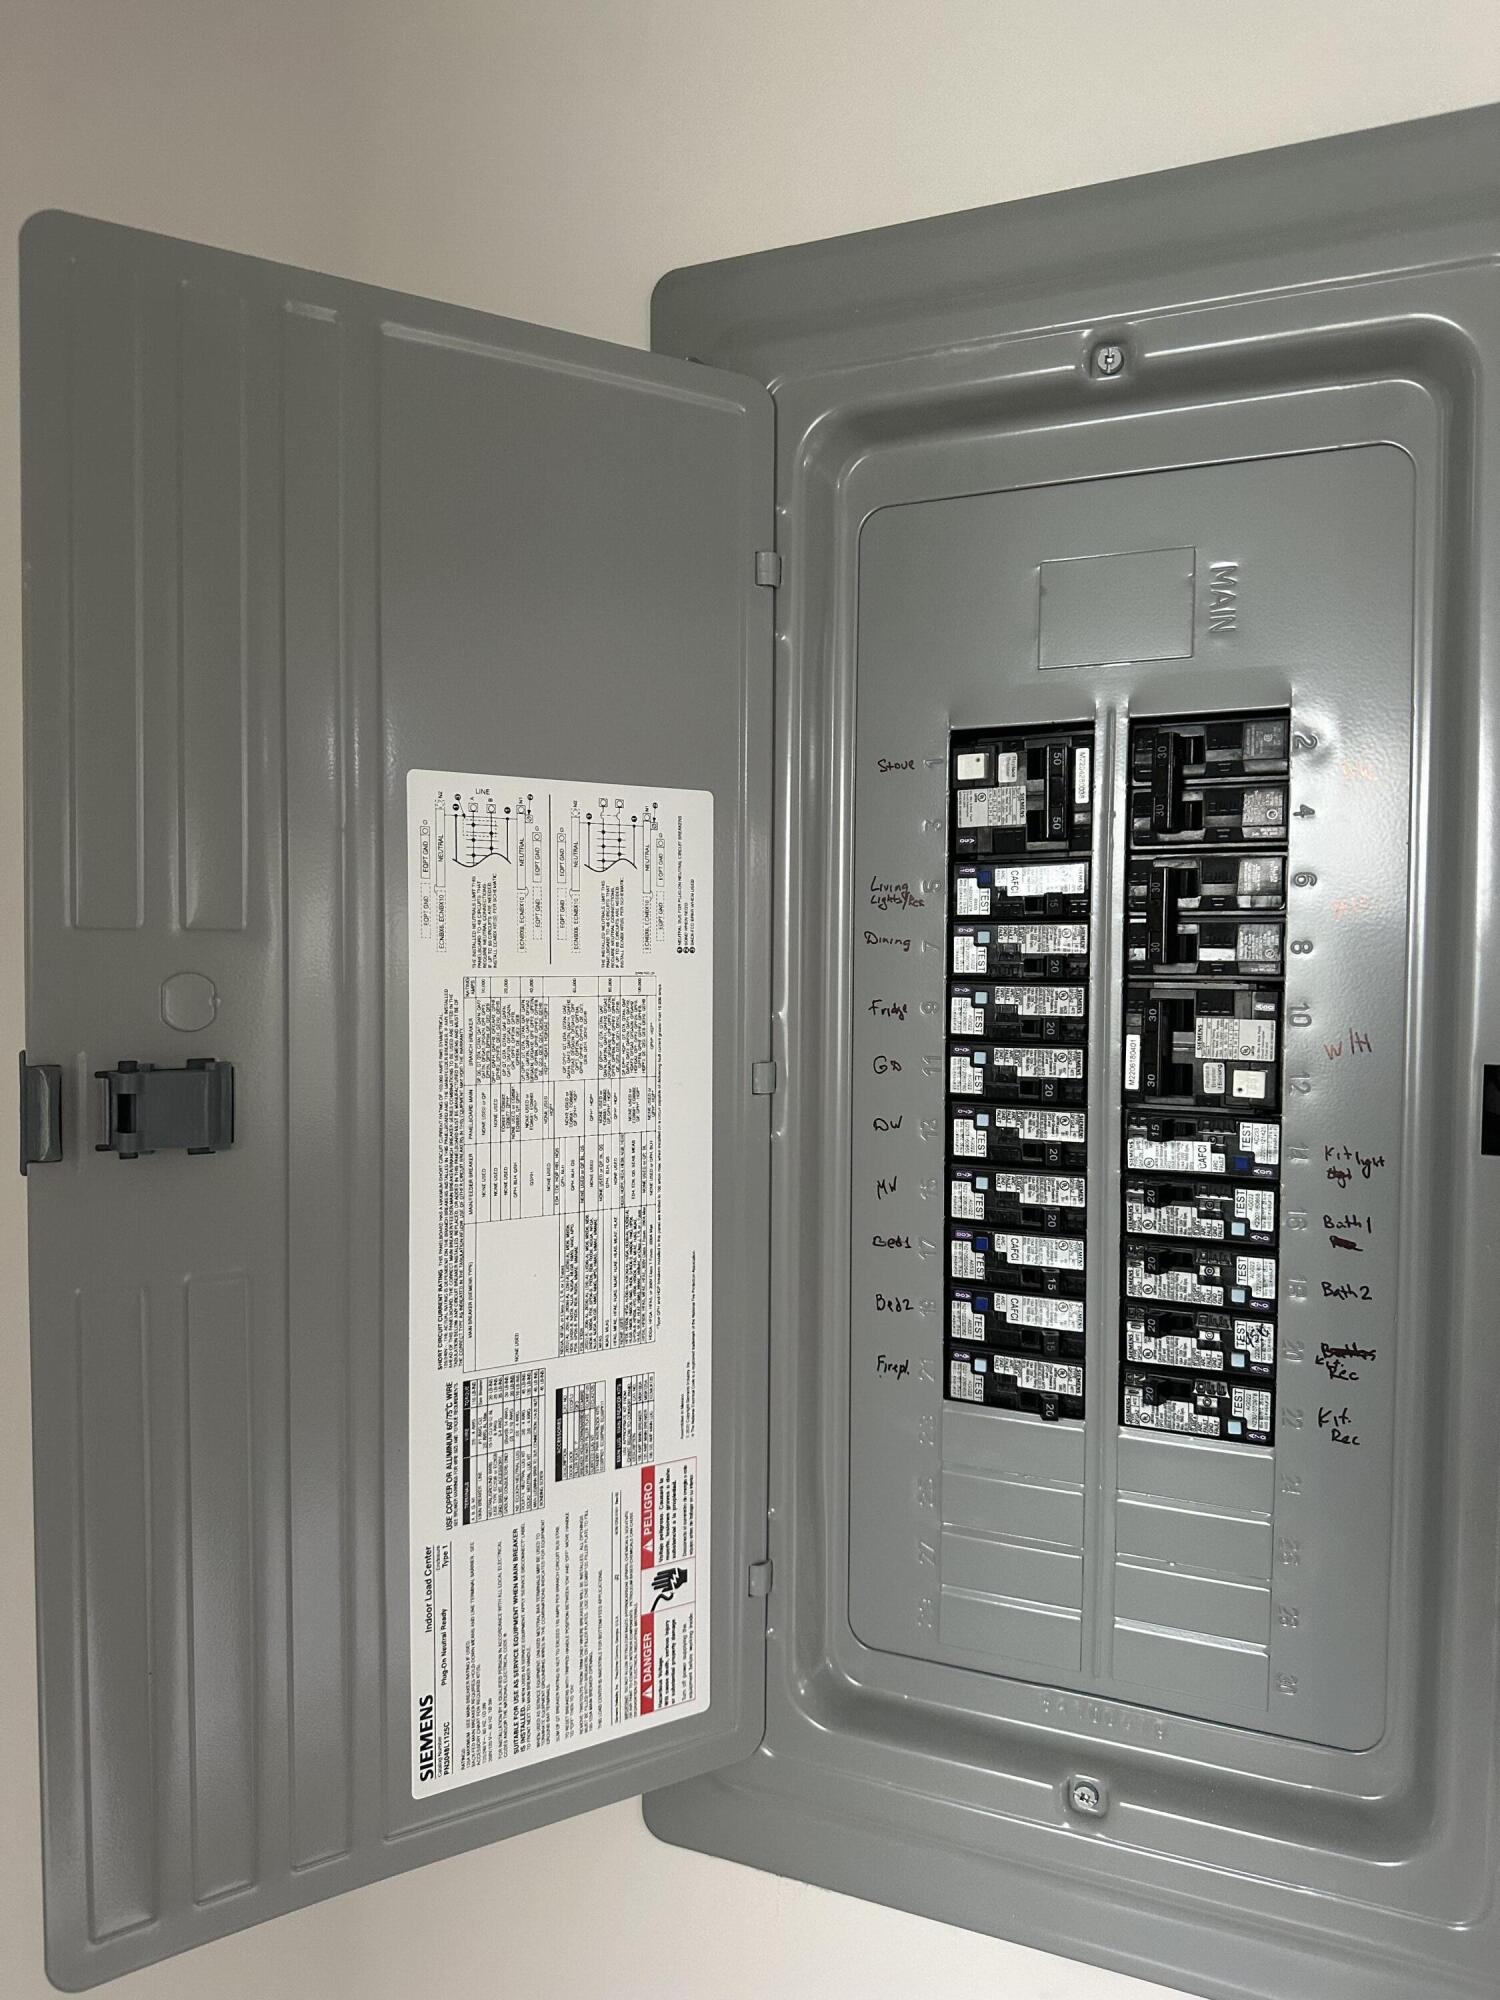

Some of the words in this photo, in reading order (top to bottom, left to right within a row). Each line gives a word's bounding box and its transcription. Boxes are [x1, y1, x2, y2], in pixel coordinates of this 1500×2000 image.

[1208, 561, 1240, 633] MAIN
[1294, 734, 1318, 750] 2
[1053, 752, 1062, 766] 50
[1157, 745, 1167, 759] 30
[877, 759, 915, 772] Stove
[475, 788, 490, 796] LINE
[1156, 803, 1165, 817] 30
[1293, 804, 1316, 819] 4
[1053, 816, 1062, 831] 50
[436, 834, 444, 863] NEUTRAL
[870, 875, 908, 894] Living
[921, 880, 943, 893] 5
[1010, 869, 1020, 894] CAFCI
[1152, 882, 1161, 893] 30
[1292, 872, 1317, 888] 6
[980, 889, 989, 913] TEST
[1049, 898, 1059, 908] 15
[864, 931, 911, 952] Dining
[1152, 941, 1161, 953] 30
[1291, 940, 1313, 955] 8
[977, 948, 986, 972] TEST
[1050, 959, 1059, 973] 20
[868, 1000, 908, 1020] Fridge
[1148, 1008, 1158, 1022] 30
[1288, 1002, 1312, 1027] 10
[975, 1010, 983, 1033] TEST
[1046, 1021, 1055, 1035] 20
[974, 1069, 982, 1093] TEST
[1147, 1073, 1156, 1088] 30
[1289, 1071, 1311, 1096] 12
[1044, 1083, 1054, 1097] 20
[1151, 1124, 1160, 1137] 15
[1242, 1124, 1251, 1149] TEST
[977, 1133, 986, 1156] TEST
[1049, 1147, 1058, 1161] 20
[1197, 1145, 1207, 1169] CAFCI
[975, 1194, 984, 1218] TEST
[1146, 1190, 1155, 1204] 20
[1236, 1190, 1245, 1215] TEST
[1048, 1214, 1057, 1228] 20
[1010, 1238, 1019, 1261] CAFCI
[976, 1255, 984, 1279] TEST
[1147, 1257, 1156, 1270] 20
[1237, 1257, 1246, 1283] TEST
[1047, 1278, 1057, 1290] 15
[1321, 1281, 1358, 1300] Bath
[1010, 1298, 1019, 1321] CAFCI
[974, 1315, 983, 1339] TEST
[1147, 1319, 1156, 1333] 20
[1236, 1321, 1245, 1347] TEST
[1047, 1340, 1056, 1351] 15
[975, 1376, 983, 1400] TEST
[1145, 1387, 1154, 1401] 20
[1045, 1403, 1055, 1417] 20
[1234, 1389, 1243, 1414] TEST
[1331, 1428, 1360, 1446] Rec
[446, 1472, 453, 1484] OR
[643, 1482, 653, 1536] PELIGRO
[424, 1546, 432, 1577] Center
[424, 1579, 432, 1601] Load
[425, 1604, 433, 1633] Indoor
[643, 1632, 653, 1683] DANGER
[513, 1679, 519, 1688] AS
[419, 1694, 434, 1782] SIEMENS
